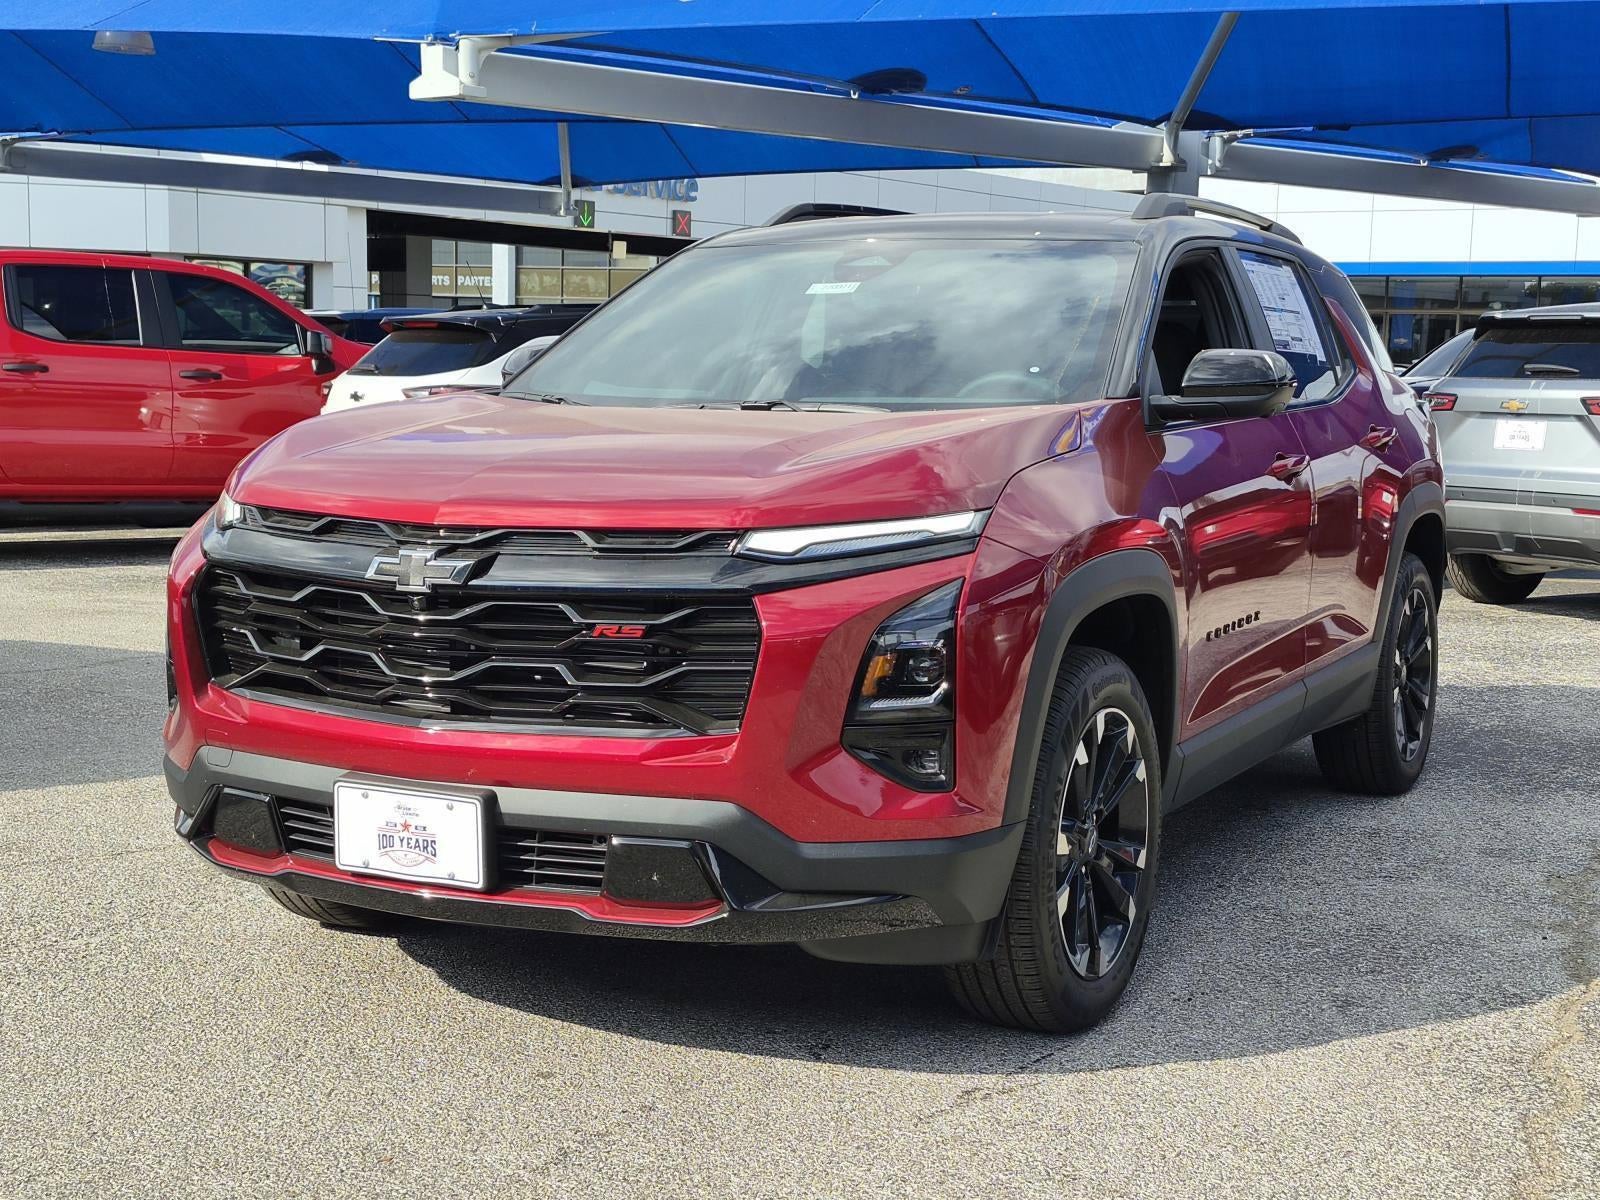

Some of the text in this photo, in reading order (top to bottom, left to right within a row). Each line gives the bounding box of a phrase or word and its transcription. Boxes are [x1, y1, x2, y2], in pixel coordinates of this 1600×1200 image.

[432, 275, 494, 287] RTS PARTE
[592, 624, 646, 639] RS
[378, 833, 436, 858] 100 YEARS
